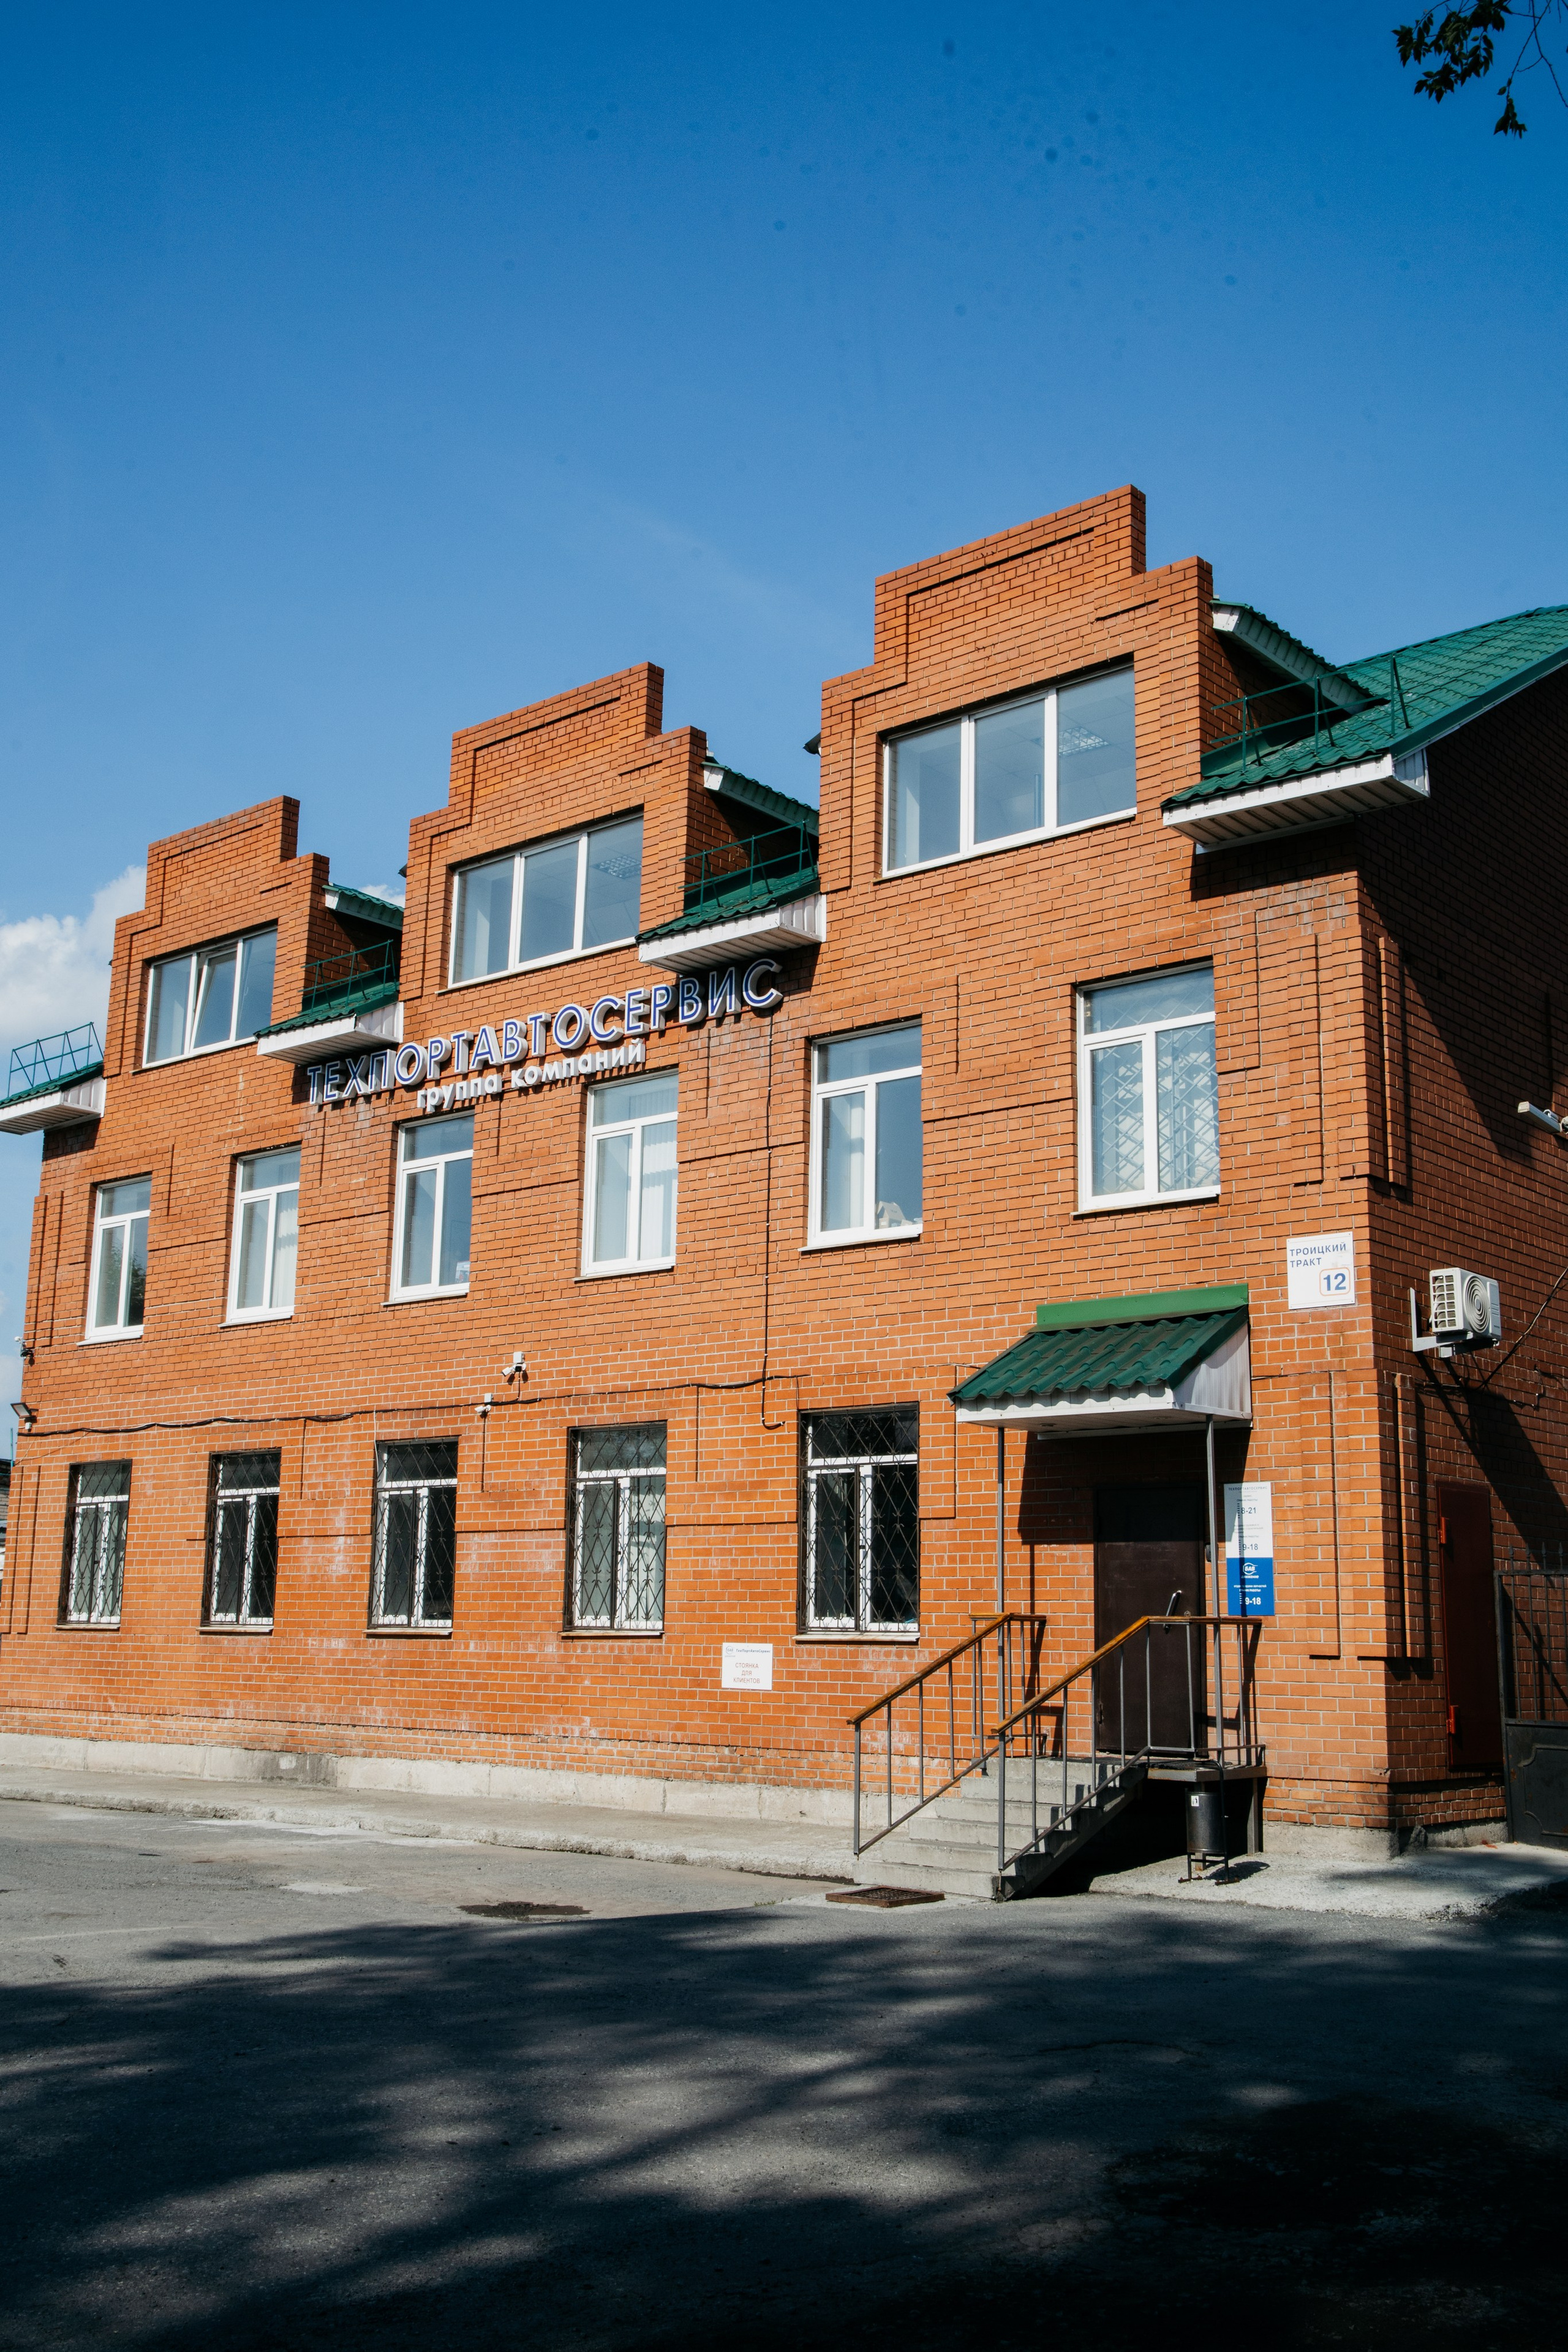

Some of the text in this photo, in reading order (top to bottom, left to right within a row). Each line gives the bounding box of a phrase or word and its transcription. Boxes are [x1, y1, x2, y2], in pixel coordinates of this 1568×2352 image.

[307, 959, 783, 1105] ТЕХПОРТАВТОСЕРВИС
[417, 1038, 646, 1112] группа компаний
[1289, 1242, 1346, 1257] ТРОИЦКИЙ
[1290, 1257, 1322, 1268] ТРАКТ
[1323, 1273, 1346, 1292] 12
